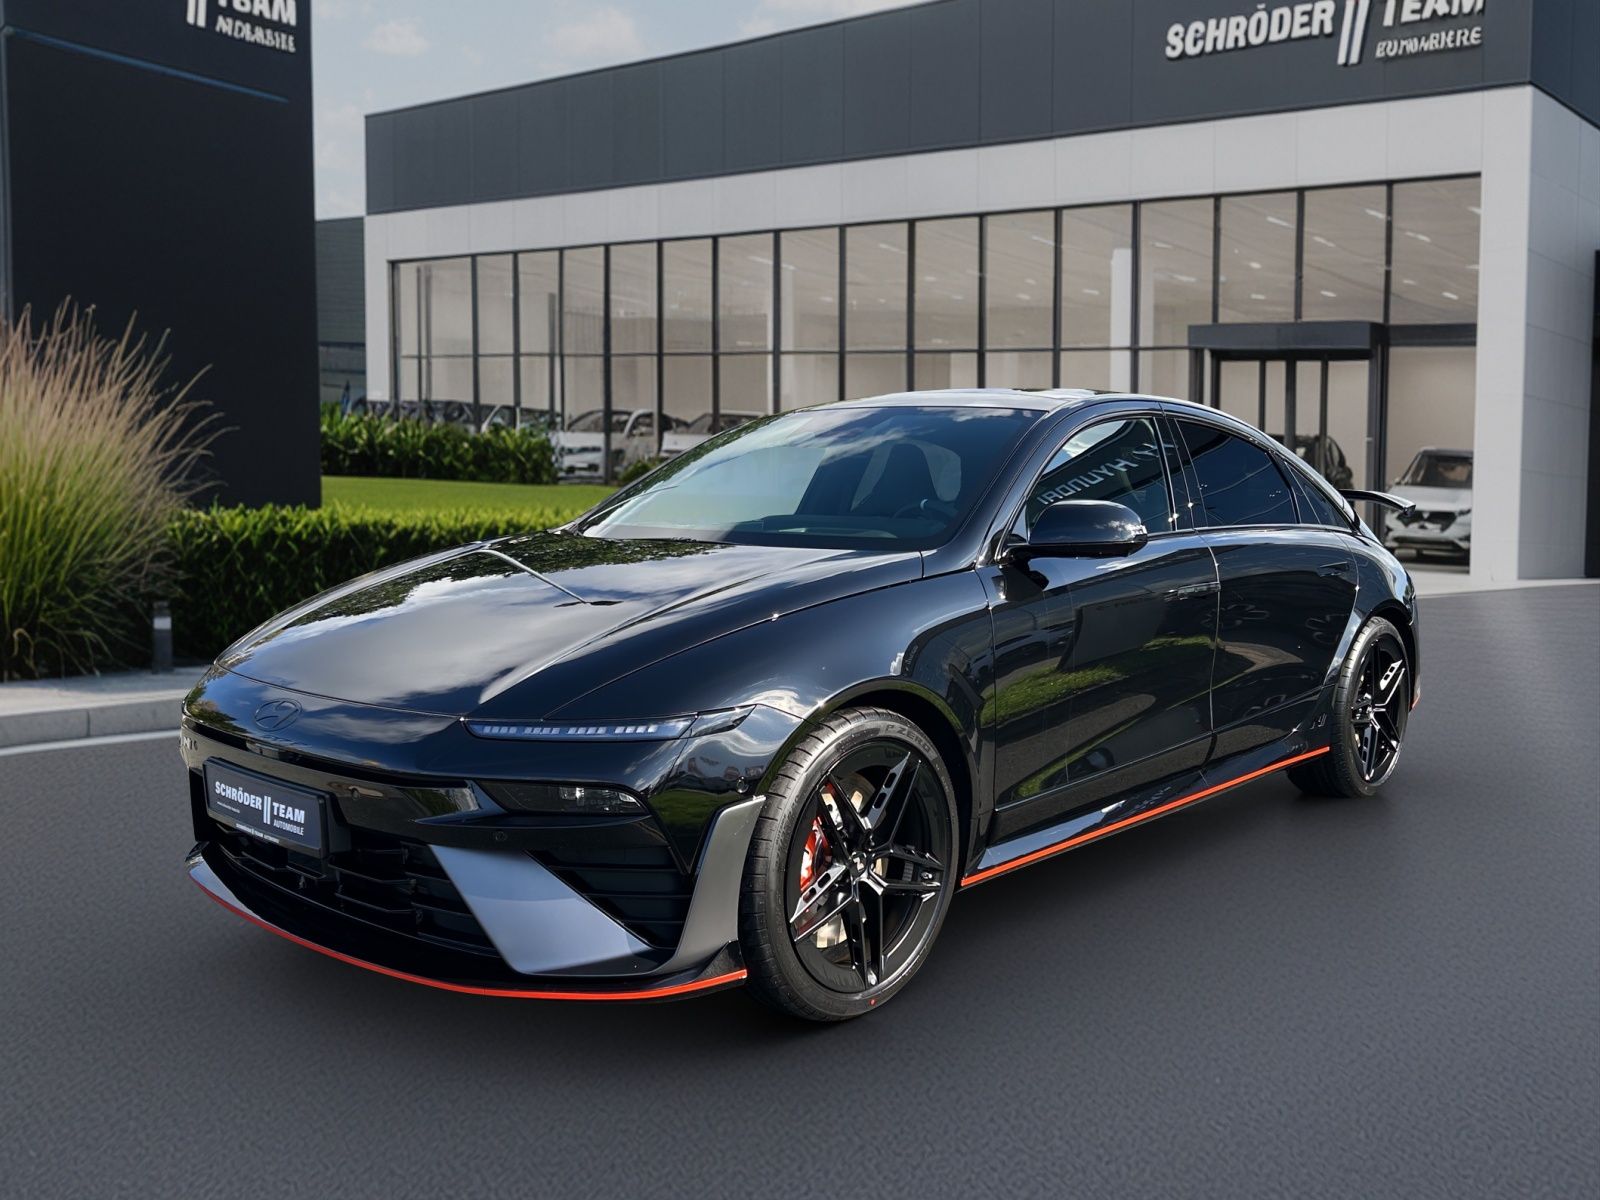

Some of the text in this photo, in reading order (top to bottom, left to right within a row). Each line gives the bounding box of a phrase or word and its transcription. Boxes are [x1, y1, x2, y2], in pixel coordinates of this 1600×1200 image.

[218, 0, 297, 26] AM
[215, 781, 262, 811] SCHRÖDER
[272, 802, 305, 824] TEAM
[273, 819, 304, 836] AUTOMOBILE
